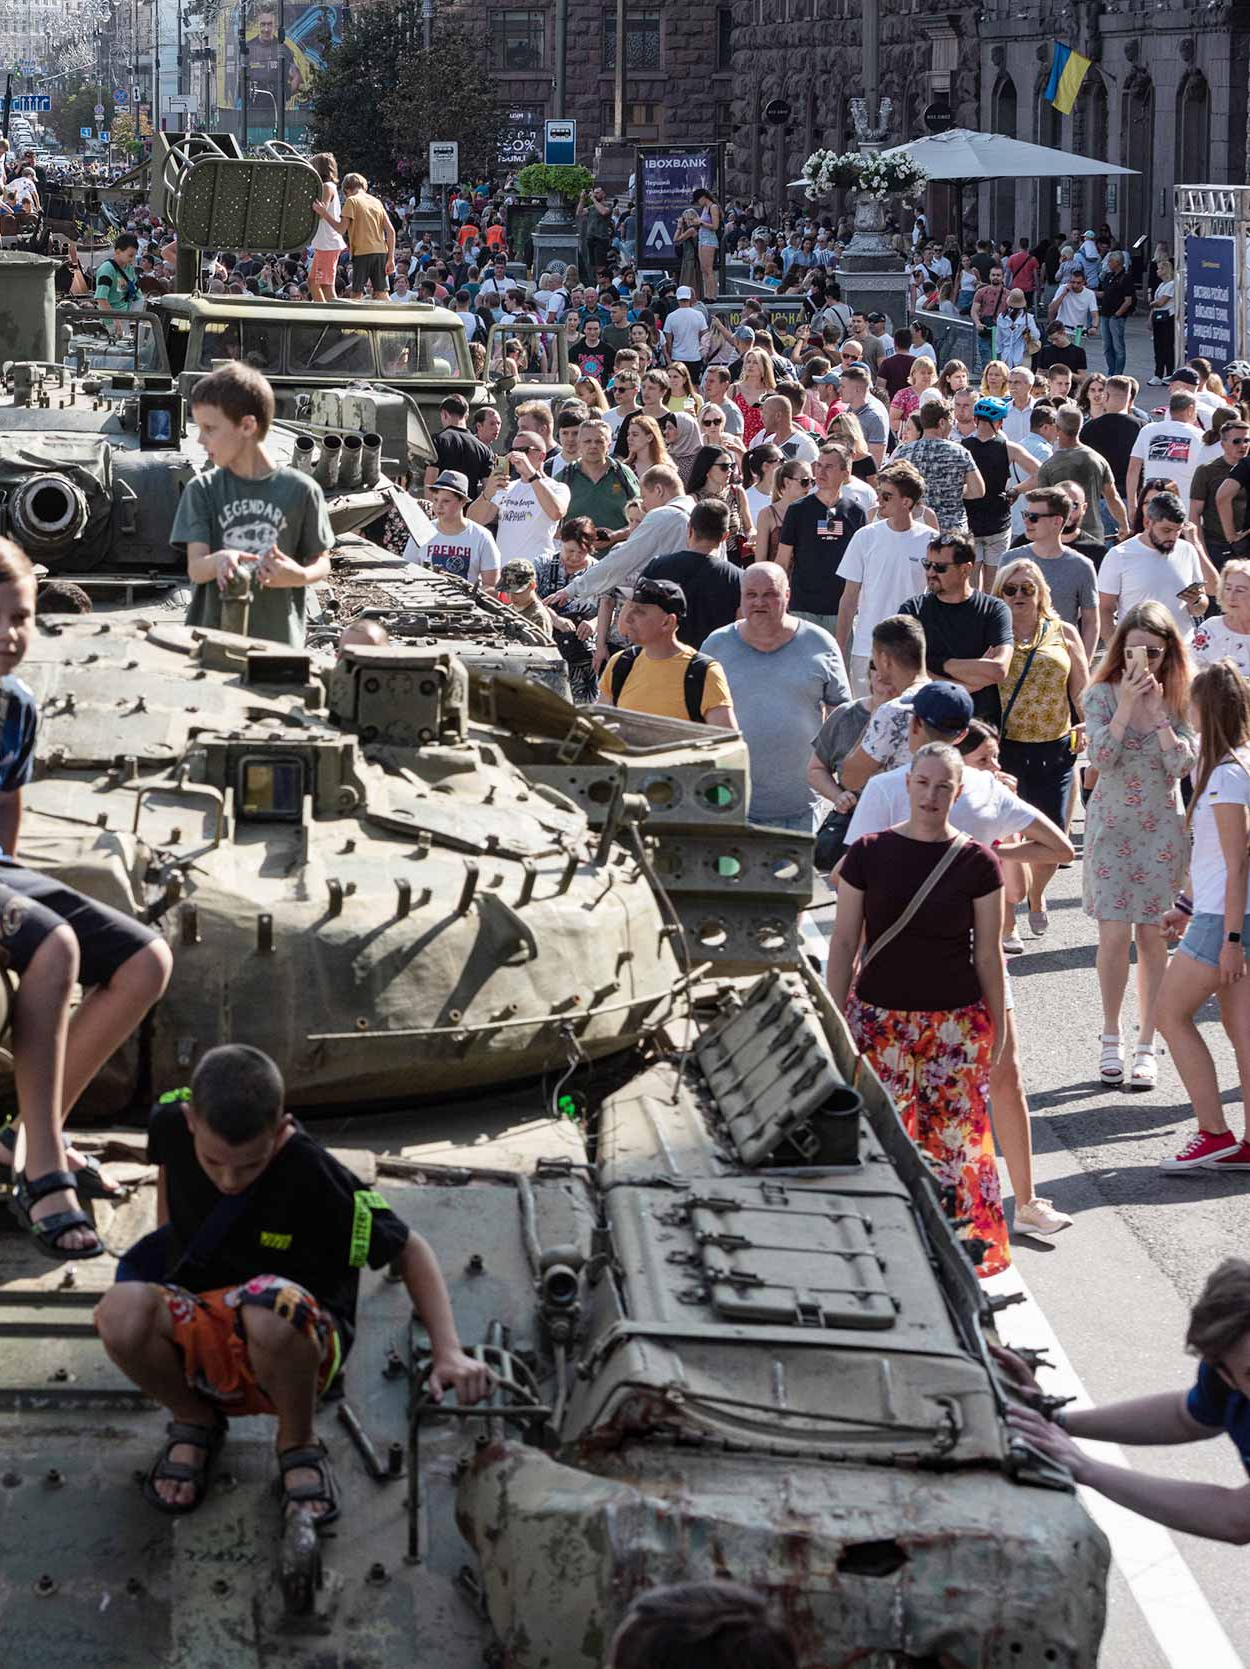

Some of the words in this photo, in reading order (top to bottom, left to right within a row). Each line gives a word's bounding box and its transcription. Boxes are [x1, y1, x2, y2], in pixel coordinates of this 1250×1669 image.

[645, 159, 707, 169] IBOXBANK
[217, 499, 288, 531] LEGENDARY
[427, 544, 471, 557] FRENCH
